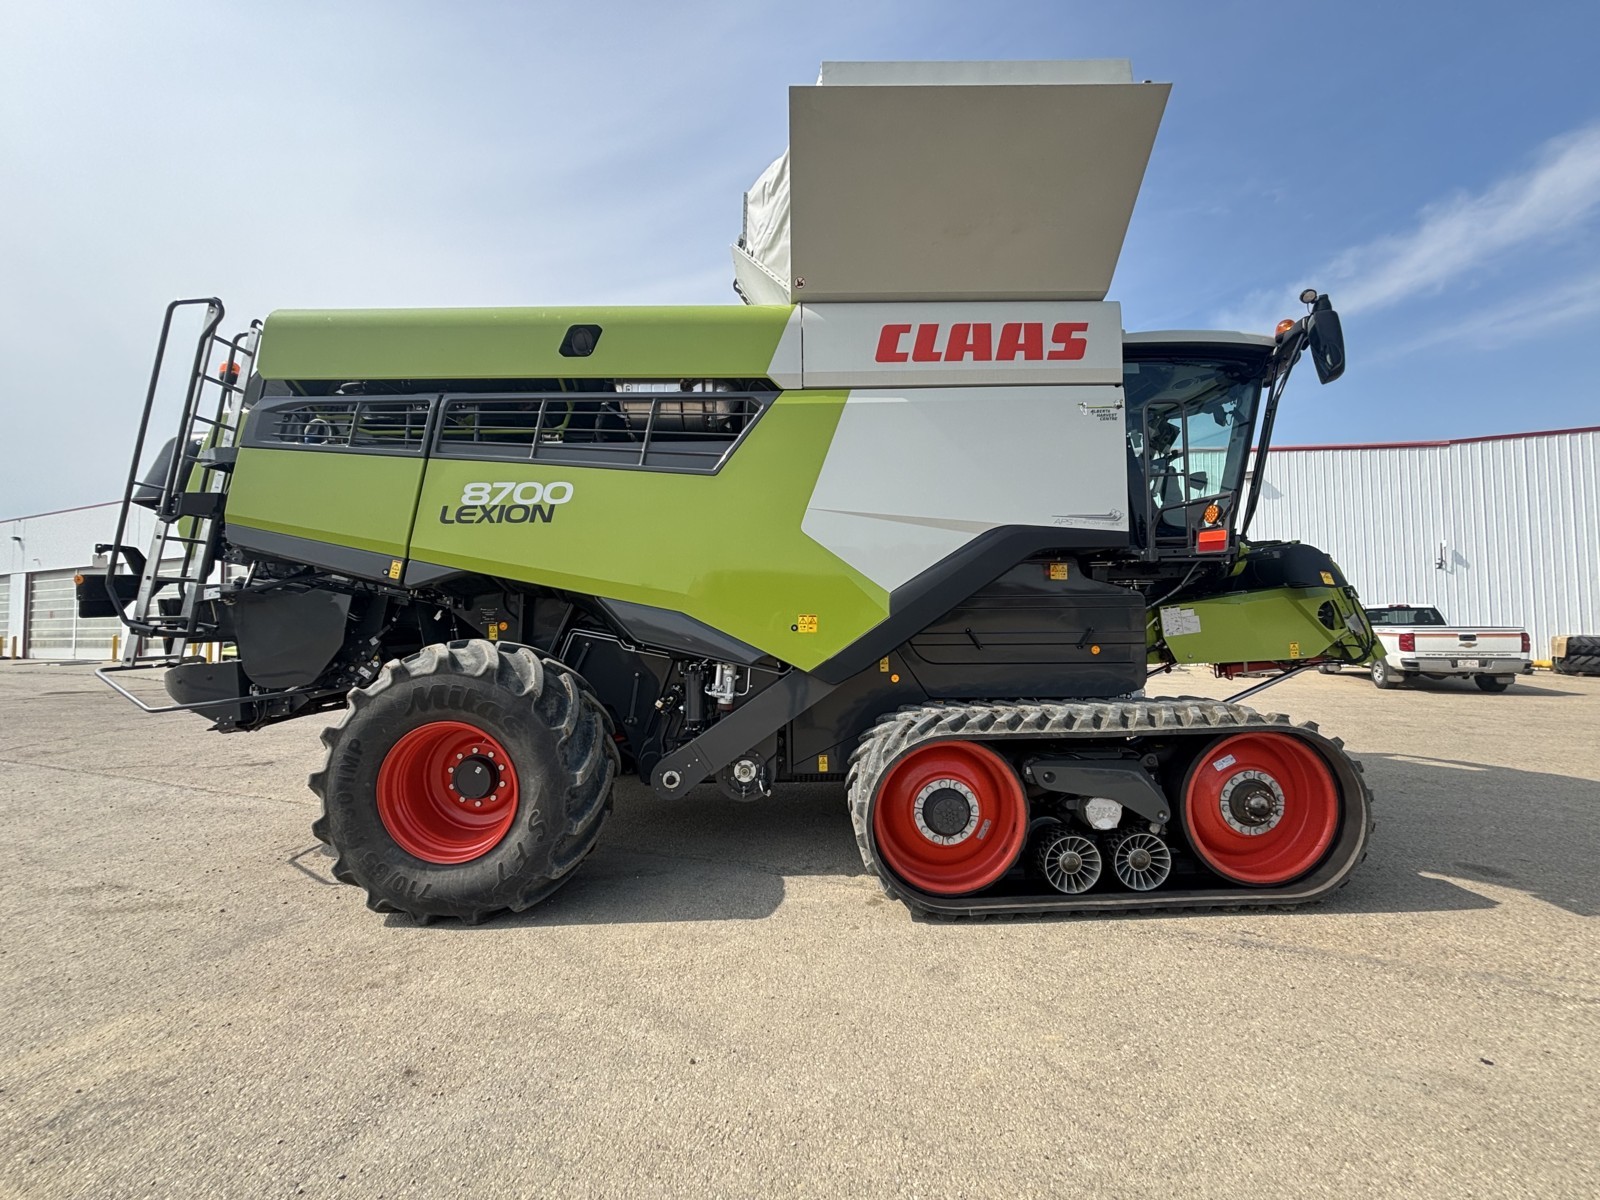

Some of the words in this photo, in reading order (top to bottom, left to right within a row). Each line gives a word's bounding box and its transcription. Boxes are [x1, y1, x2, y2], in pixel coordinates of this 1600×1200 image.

[875, 322, 1089, 362] CLAAS
[460, 481, 574, 505] 8700
[439, 504, 556, 524] LEXION
[405, 684, 524, 739] Mitas
[337, 738, 363, 783] IMP
